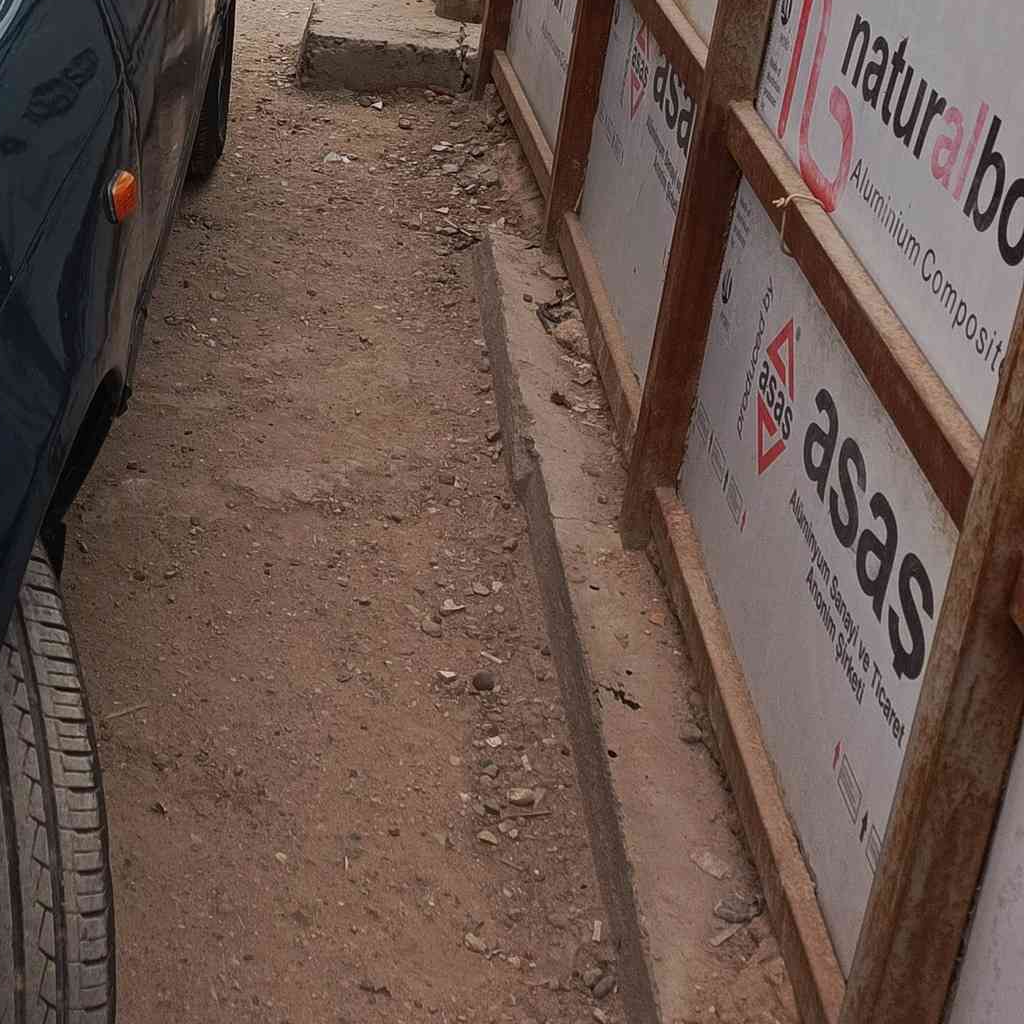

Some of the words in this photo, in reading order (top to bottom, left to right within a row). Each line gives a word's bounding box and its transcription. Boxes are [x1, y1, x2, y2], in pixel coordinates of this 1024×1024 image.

[849, 158, 921, 268] Aluminium
[921, 248, 1005, 378] Composit
[736, 309, 765, 441] produced
[805, 564, 836, 642] Anonim
[829, 575, 860, 643] Sanayi
[857, 642, 871, 673] ve
[872, 661, 905, 749] Ticaret
